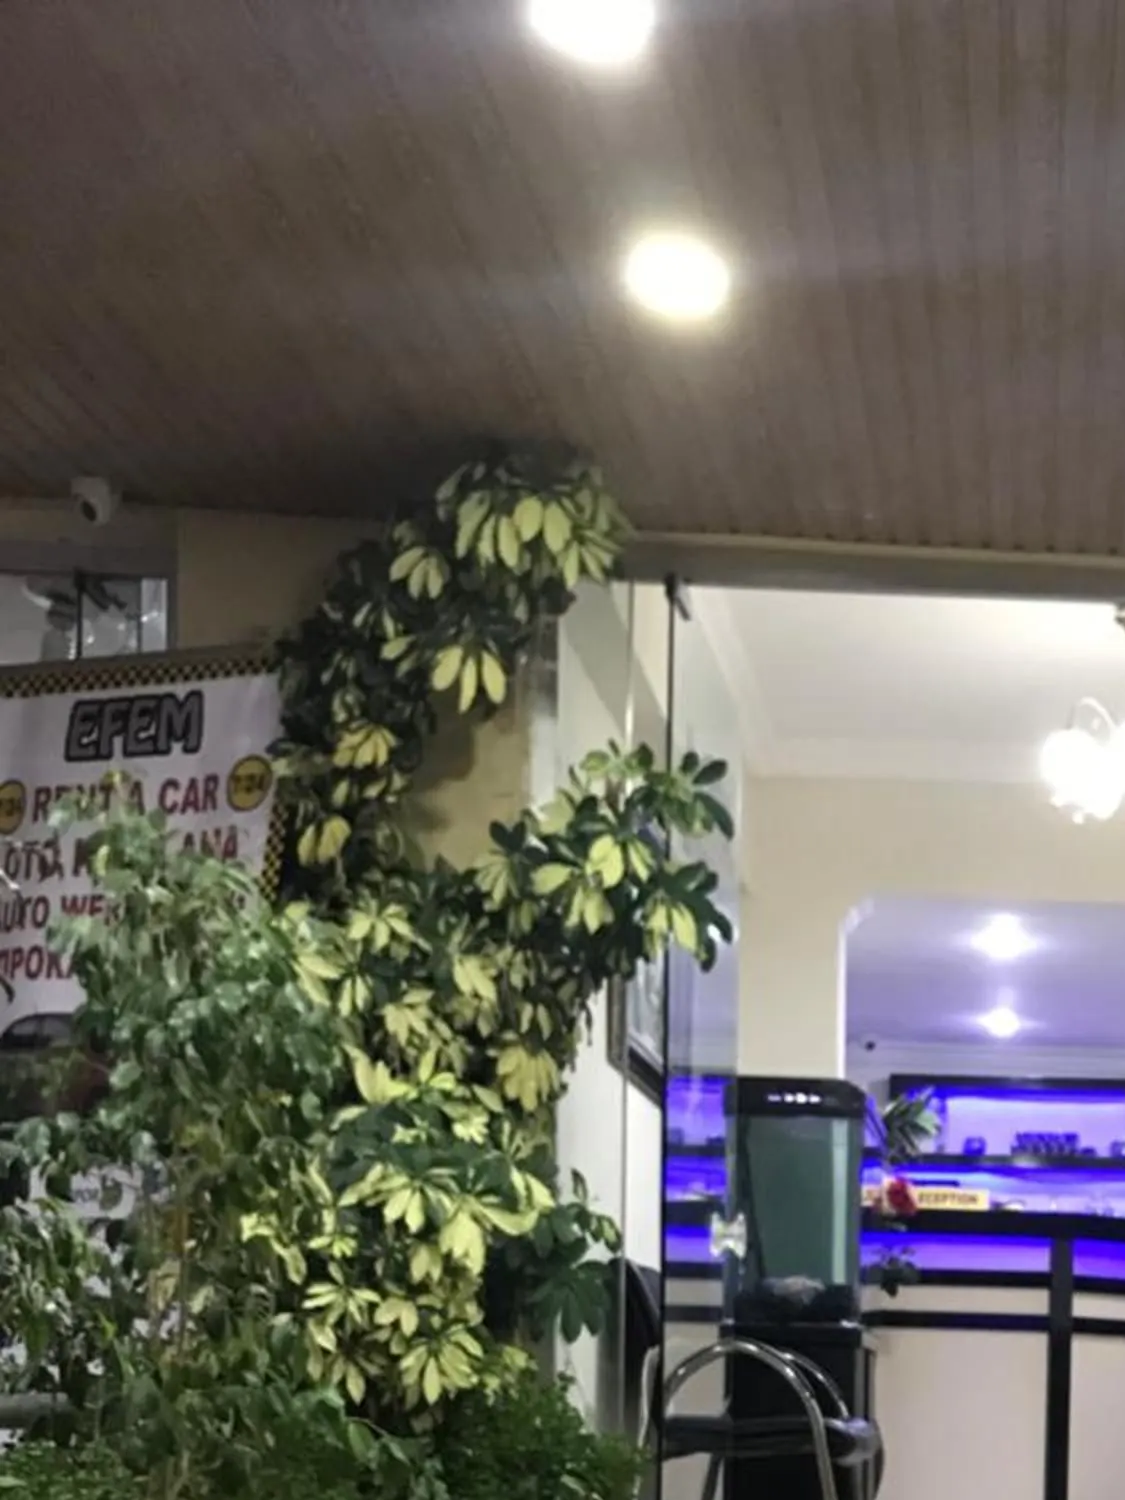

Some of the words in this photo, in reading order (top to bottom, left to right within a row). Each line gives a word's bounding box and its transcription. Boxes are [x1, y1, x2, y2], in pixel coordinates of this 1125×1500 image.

[65, 690, 205, 762] EFEM
[158, 773, 220, 815] CAR
[0, 895, 50, 933] UTO
[914, 1190, 979, 1205] ECEPTION
